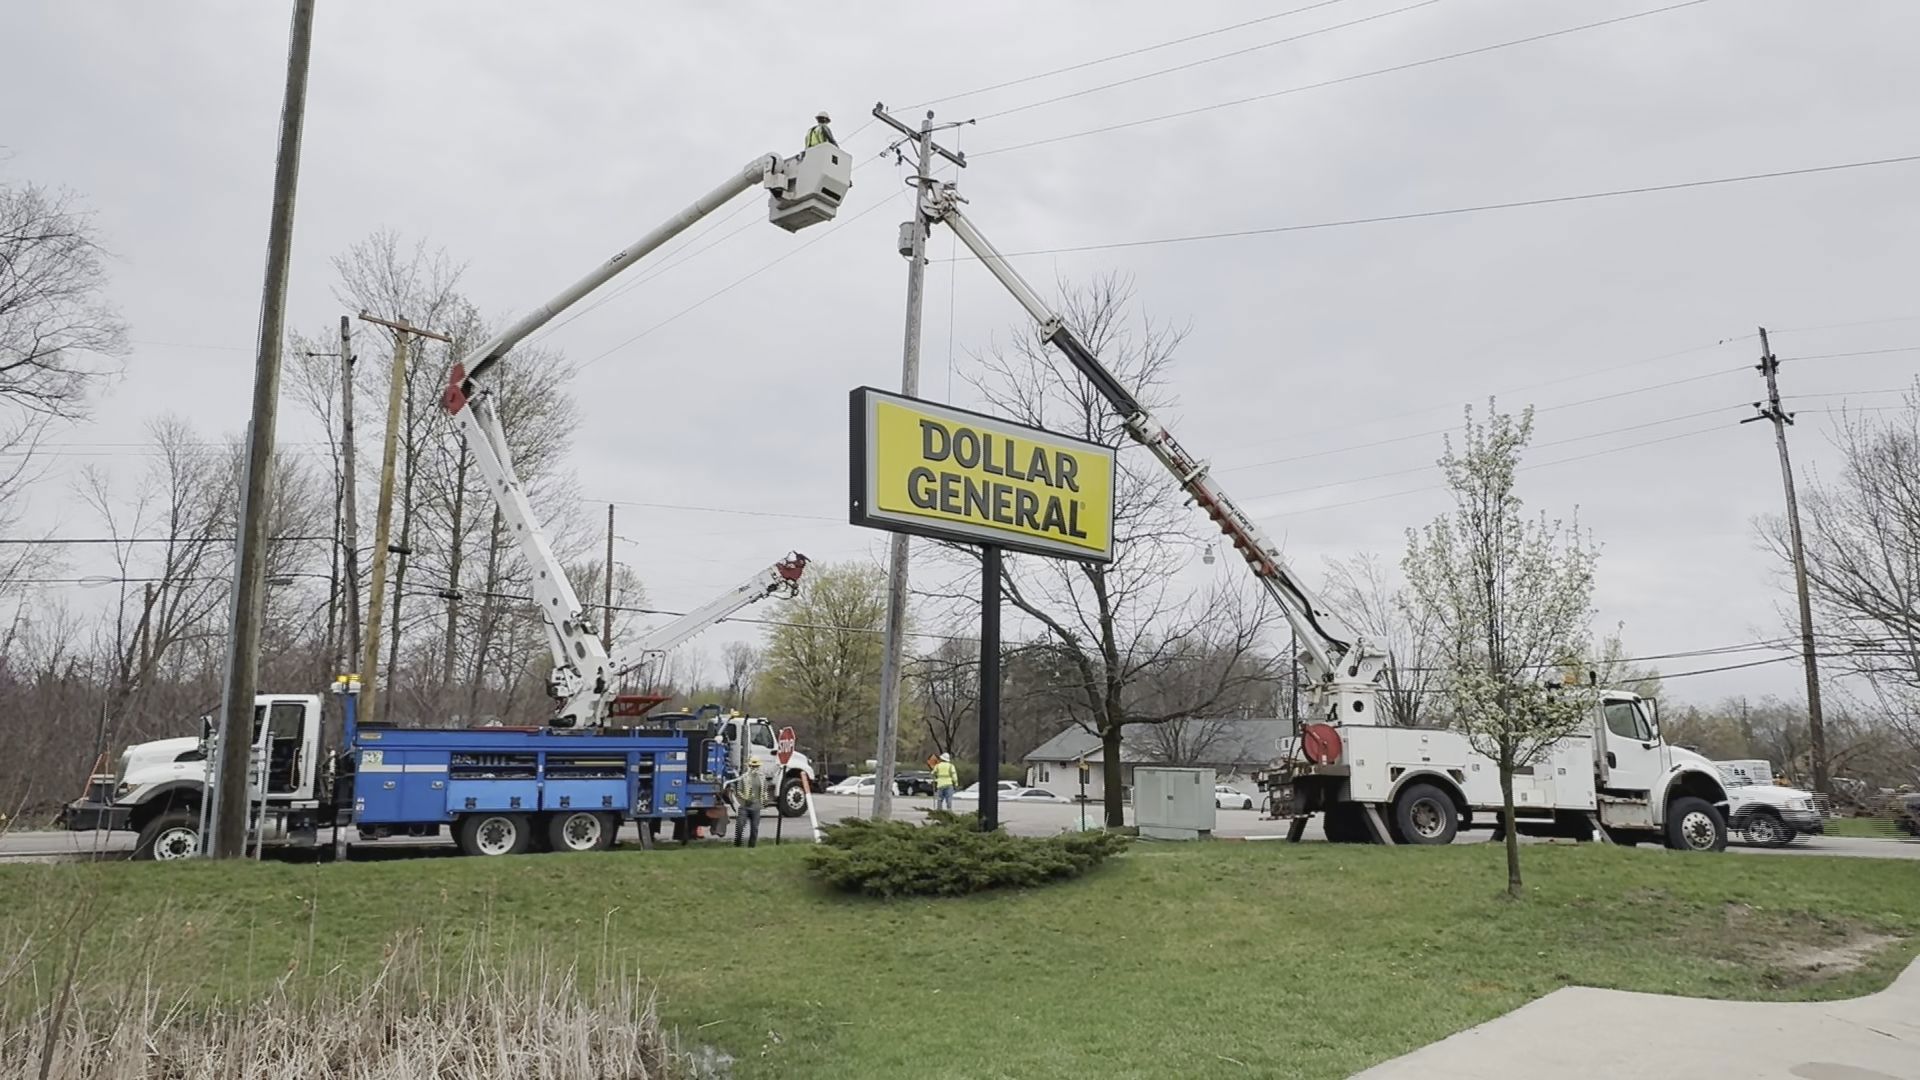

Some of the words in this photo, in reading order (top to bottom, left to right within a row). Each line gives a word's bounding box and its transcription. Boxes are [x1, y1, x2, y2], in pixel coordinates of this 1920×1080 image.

[920, 419, 1079, 492] DOLLAR
[908, 467, 1087, 539] GENERAL
[779, 739, 794, 753] STOP
